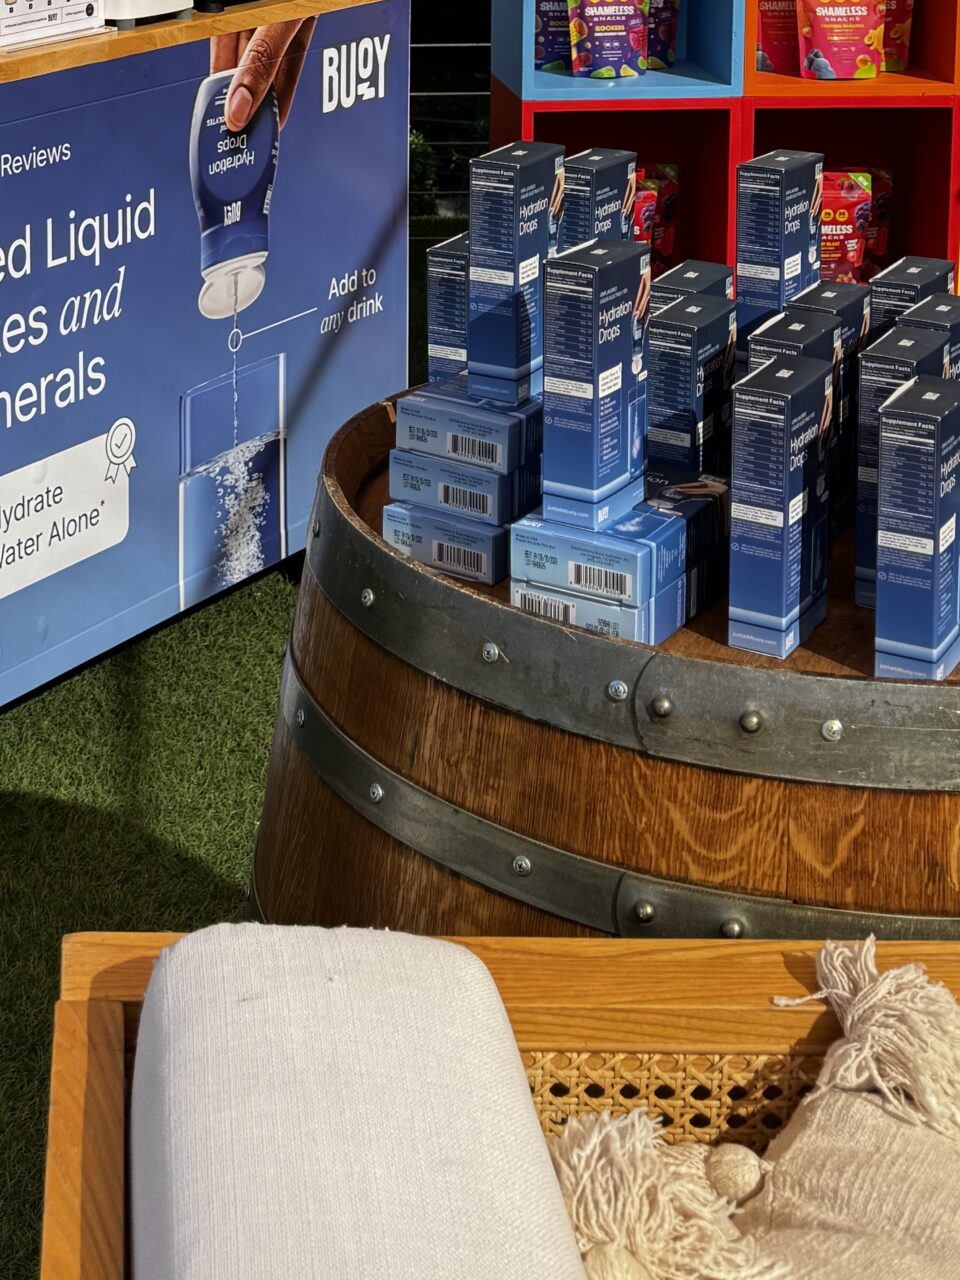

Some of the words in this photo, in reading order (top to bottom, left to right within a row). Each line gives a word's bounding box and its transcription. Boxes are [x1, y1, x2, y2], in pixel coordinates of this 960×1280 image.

[585, 5, 635, 16] SHAMELESS
[816, 6, 868, 16] SHAMELESS
[323, 34, 391, 113] BUOY
[217, 134, 247, 153] Drops
[0, 141, 72, 177] Reviews
[209, 149, 255, 175] Hydration
[224, 201, 242, 226] BUOY
[520, 197, 548, 220] Hydration
[595, 199, 621, 219] Hydration
[784, 200, 809, 220] Hydration
[45, 187, 156, 268] Liquid
[519, 219, 538, 236] Drops
[594, 218, 611, 235] Drops
[784, 219, 800, 234] Drops
[547, 267, 577, 277] Supplement
[328, 271, 358, 300] Add
[361, 267, 376, 287] to
[58, 265, 126, 336] and
[320, 310, 344, 335] any
[348, 292, 384, 324] drink
[599, 301, 632, 327] Hydration
[599, 324, 620, 344] Drops
[750, 343, 782, 354] Supplement
[782, 348, 797, 356] Facts
[862, 360, 895, 370] Supplement
[735, 393, 769, 403] Supplement
[769, 398, 785, 406] Facts
[882, 417, 918, 428] Supplement
[918, 422, 935, 430] Facts
[790, 424, 818, 454] Hydration
[790, 449, 808, 472] Drops
[940, 474, 956, 498] Drops
